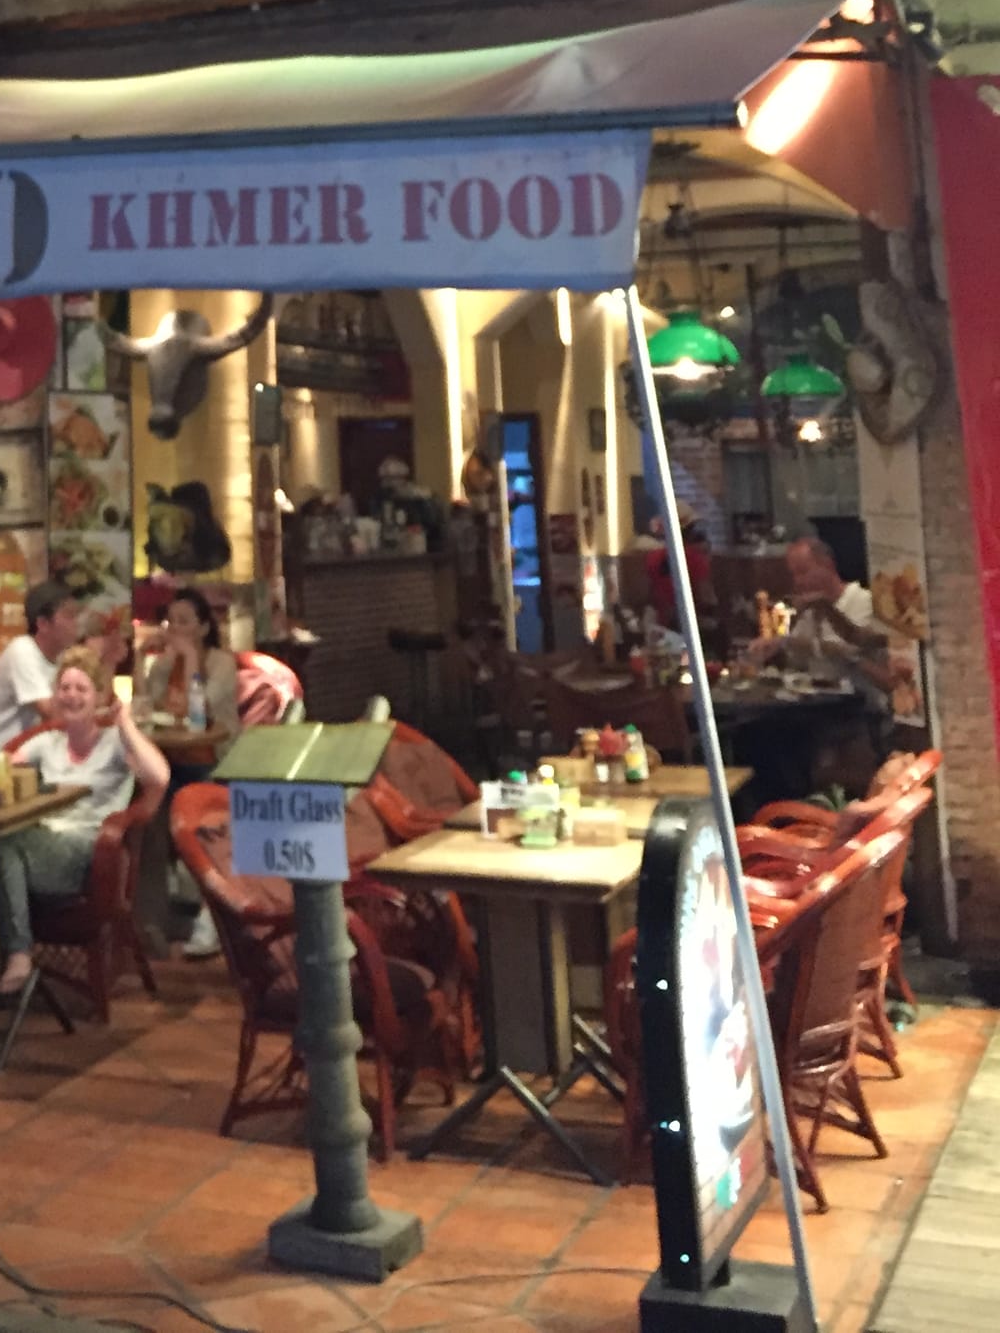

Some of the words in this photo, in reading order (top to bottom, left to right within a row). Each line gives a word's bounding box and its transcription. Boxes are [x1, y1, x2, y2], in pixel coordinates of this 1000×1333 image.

[89, 183, 371, 253] KHMER
[402, 171, 624, 245] FOOD
[232, 788, 284, 821] Draft
[288, 789, 344, 823] Glass
